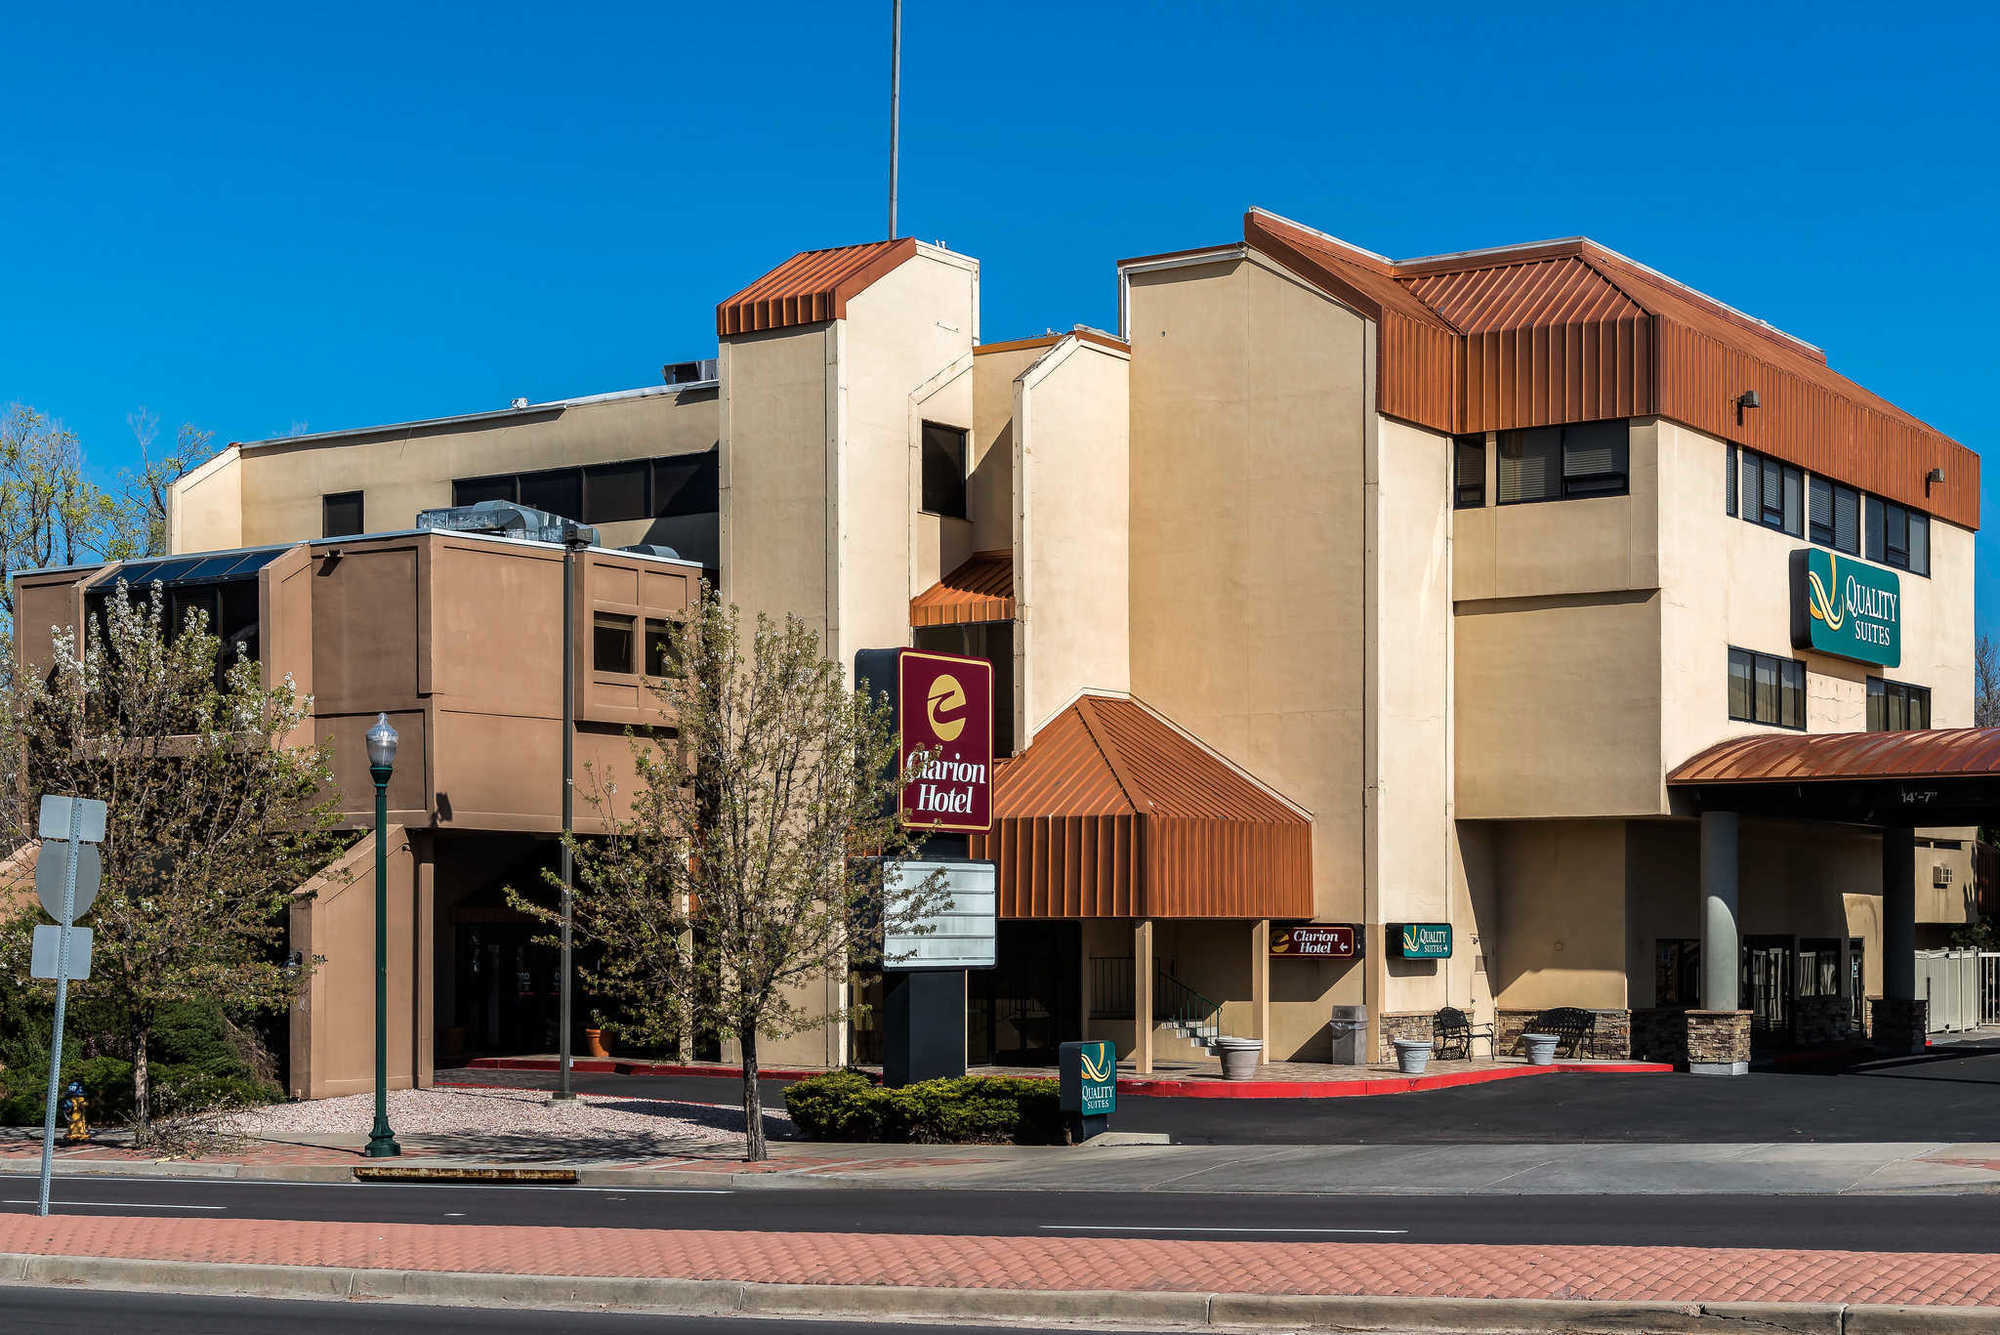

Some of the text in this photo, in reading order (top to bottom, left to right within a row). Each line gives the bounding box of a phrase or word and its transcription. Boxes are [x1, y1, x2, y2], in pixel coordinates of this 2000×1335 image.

[1846, 575, 1897, 622] QUALITY
[1855, 620, 1890, 647] SUITES
[905, 750, 986, 784] Clarion
[917, 783, 973, 813] Hotel
[1293, 930, 1339, 942] Clarion
[1420, 928, 1447, 944] QUALITY
[1300, 942, 1331, 953] Hotel
[1424, 944, 1442, 953] SUITES
[1082, 1085, 1114, 1102] QUALITY
[1087, 1099, 1110, 1109] SUITES
